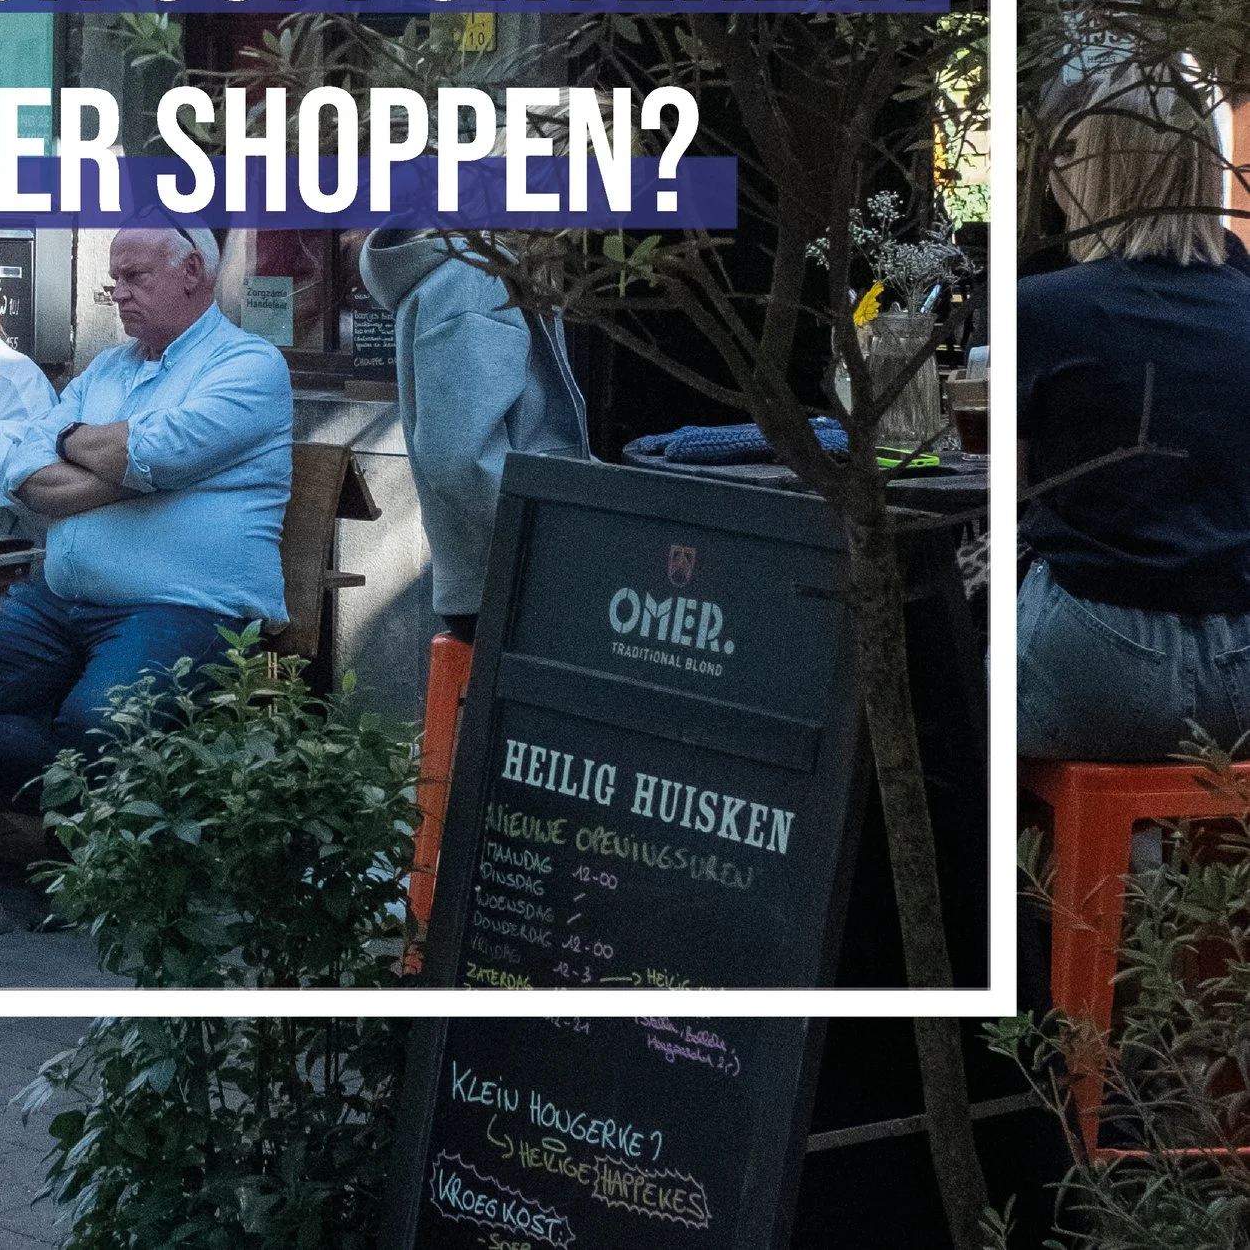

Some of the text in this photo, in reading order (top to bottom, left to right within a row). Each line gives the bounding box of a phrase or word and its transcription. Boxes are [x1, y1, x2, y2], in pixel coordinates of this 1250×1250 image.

[609, 587, 735, 655] OMER.
[611, 641, 723, 677] TRADITIONAL BLOND
[501, 739, 796, 855] HEILIG HUISKEN
[600, 1164, 706, 1220] HAPPEKES
